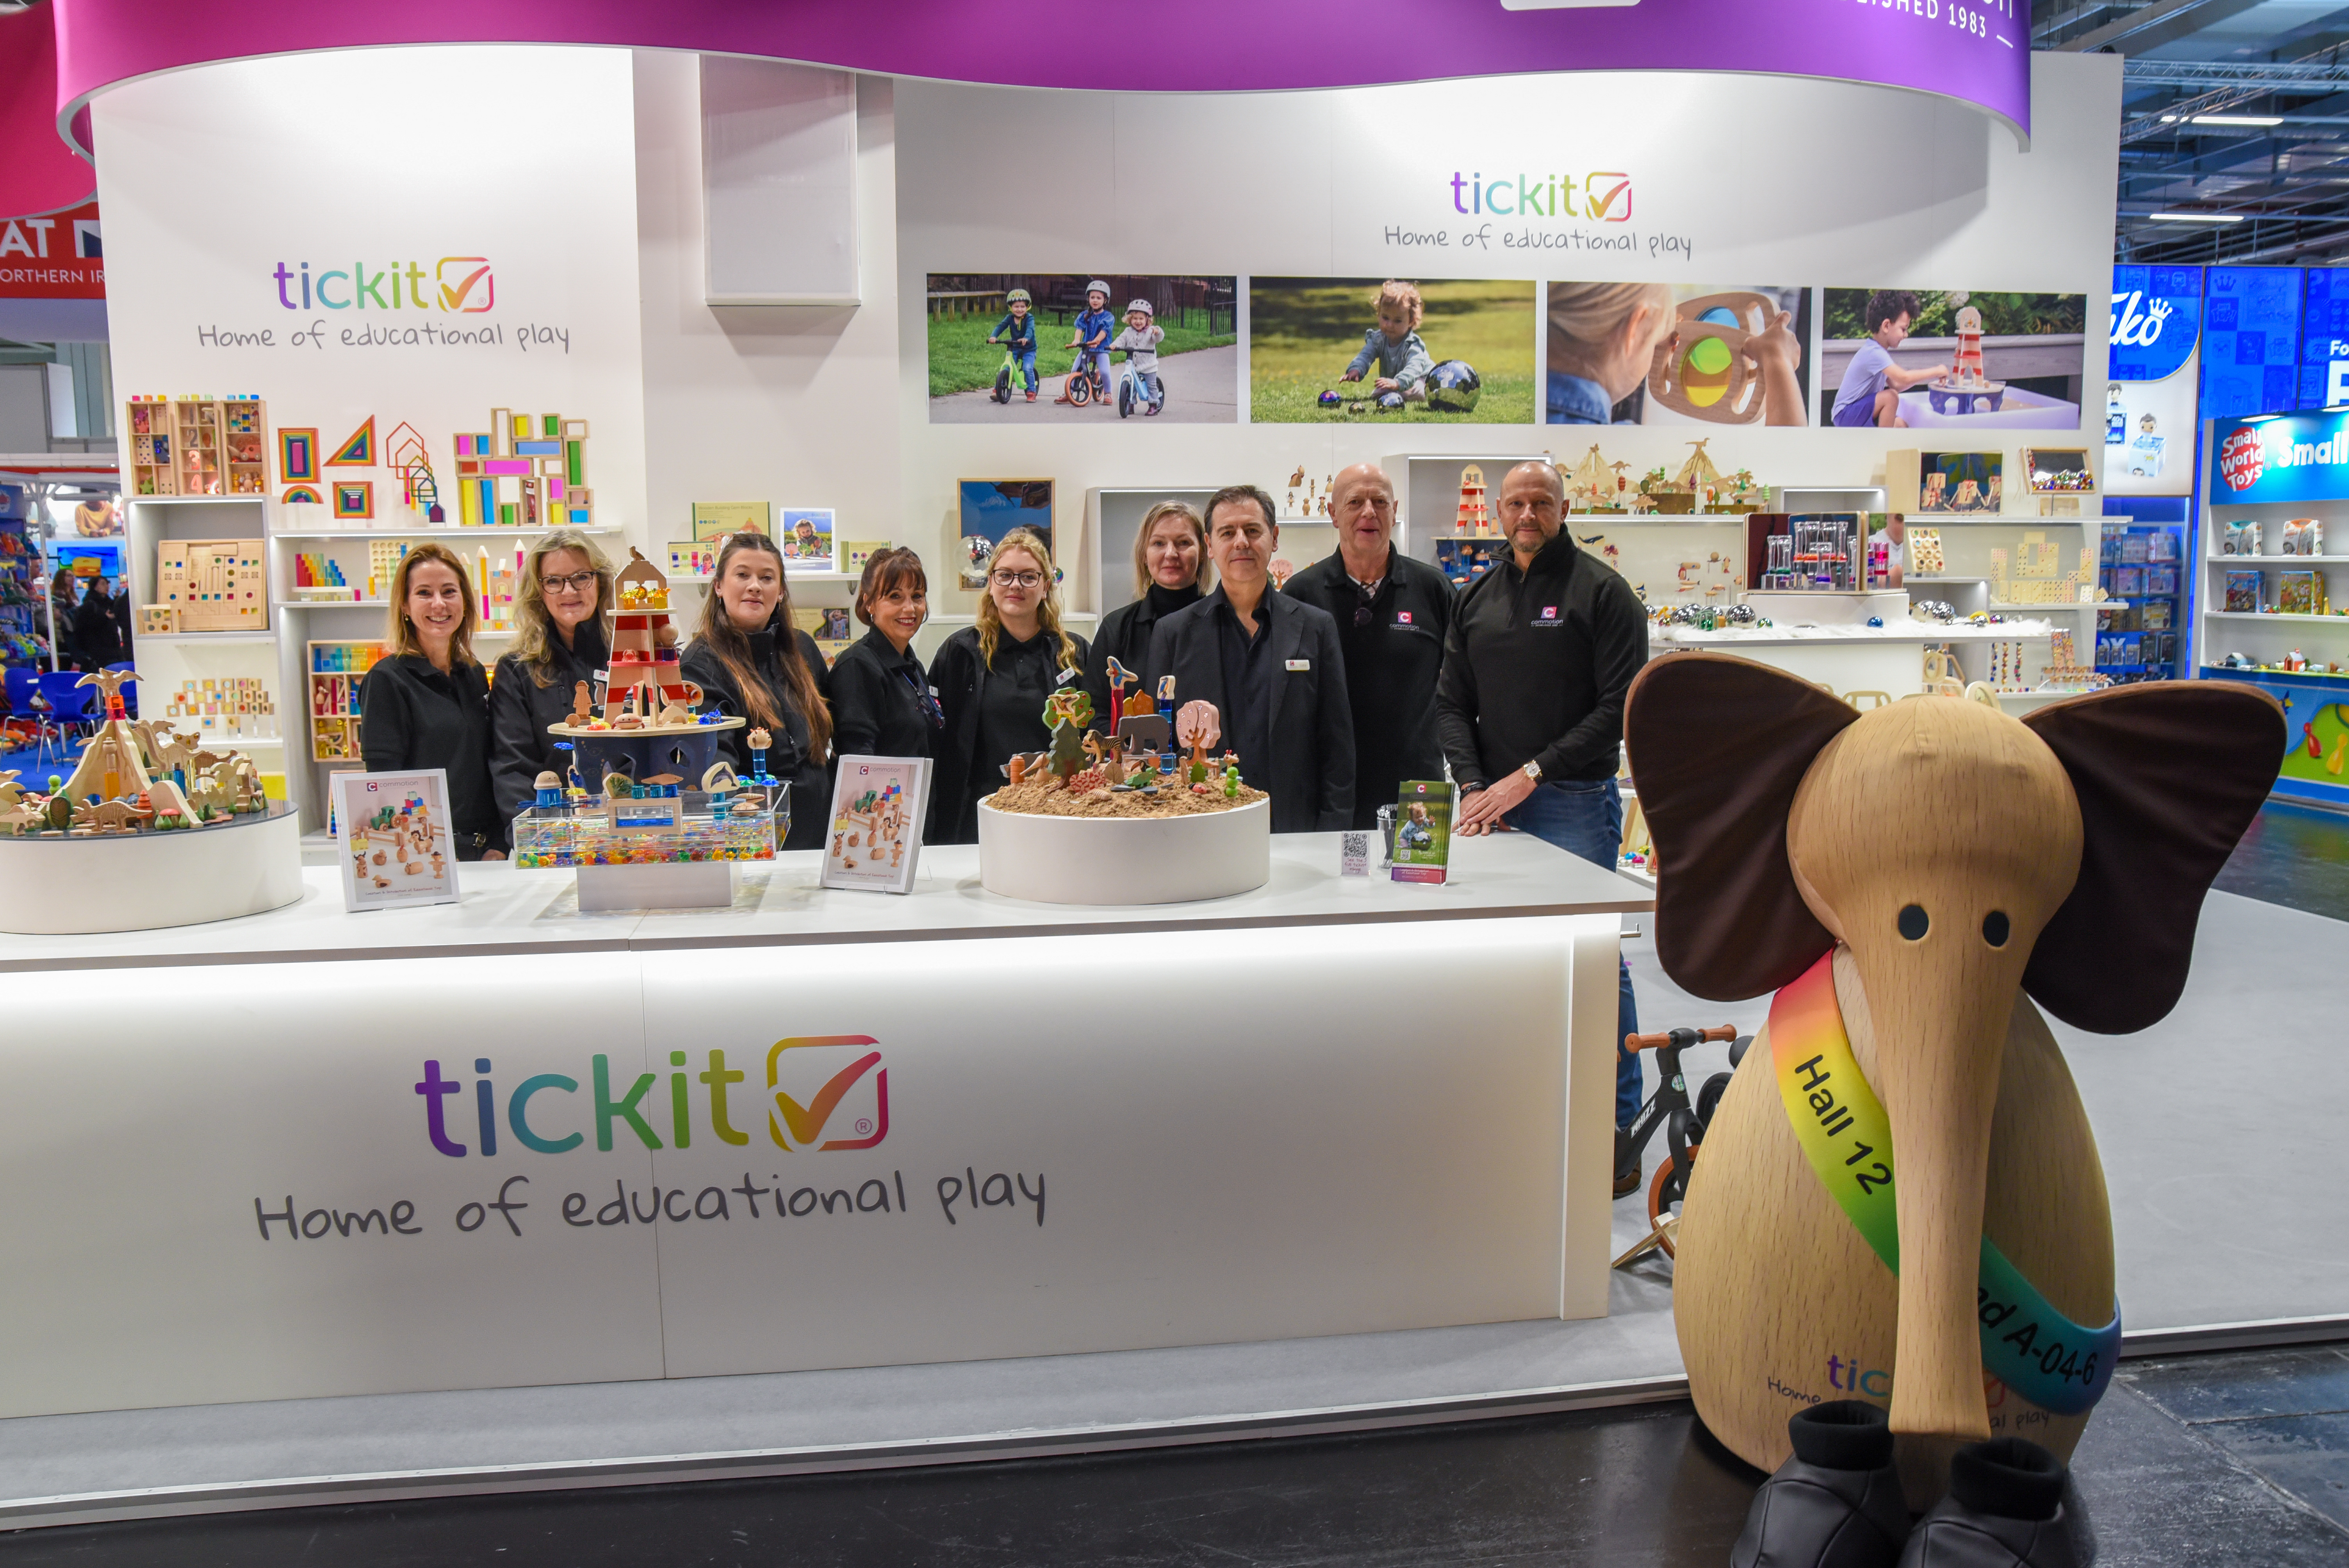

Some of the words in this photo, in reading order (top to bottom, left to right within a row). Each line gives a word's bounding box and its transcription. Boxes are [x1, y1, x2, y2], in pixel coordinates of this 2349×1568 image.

[1949, 3, 1985, 37] 1983
[1450, 171, 1578, 217] tickit
[1385, 225, 1449, 246] Home
[1462, 223, 1492, 250] of
[1503, 228, 1637, 251] educational
[1649, 232, 1691, 262] play
[273, 262, 429, 310] tickit
[198, 324, 276, 347] Home
[291, 319, 326, 349] of
[341, 322, 503, 346] educational
[517, 323, 569, 354] play
[189, 450, 200, 470] 3
[2221, 447, 2265, 475] World
[2277, 430, 2349, 468] Small
[191, 474, 202, 494] 4
[2228, 465, 2263, 492] Toys
[1400, 613, 1409, 622] C
[1543, 608, 1554, 618] C
[1417, 784, 1425, 793] C
[415, 1049, 749, 1157] tickit
[1631, 1098, 1656, 1138] WHIZZ
[1795, 1054, 1854, 1137] Hall
[1845, 1140, 1892, 1195] 12
[255, 1195, 422, 1240] Home
[456, 1176, 530, 1237] of
[562, 1171, 906, 1227] educational
[937, 1167, 1047, 1227] play
[2002, 1322, 2098, 1386] A-04-6
[1768, 1376, 1821, 1404] Home
[2016, 1411, 2049, 1430] play
